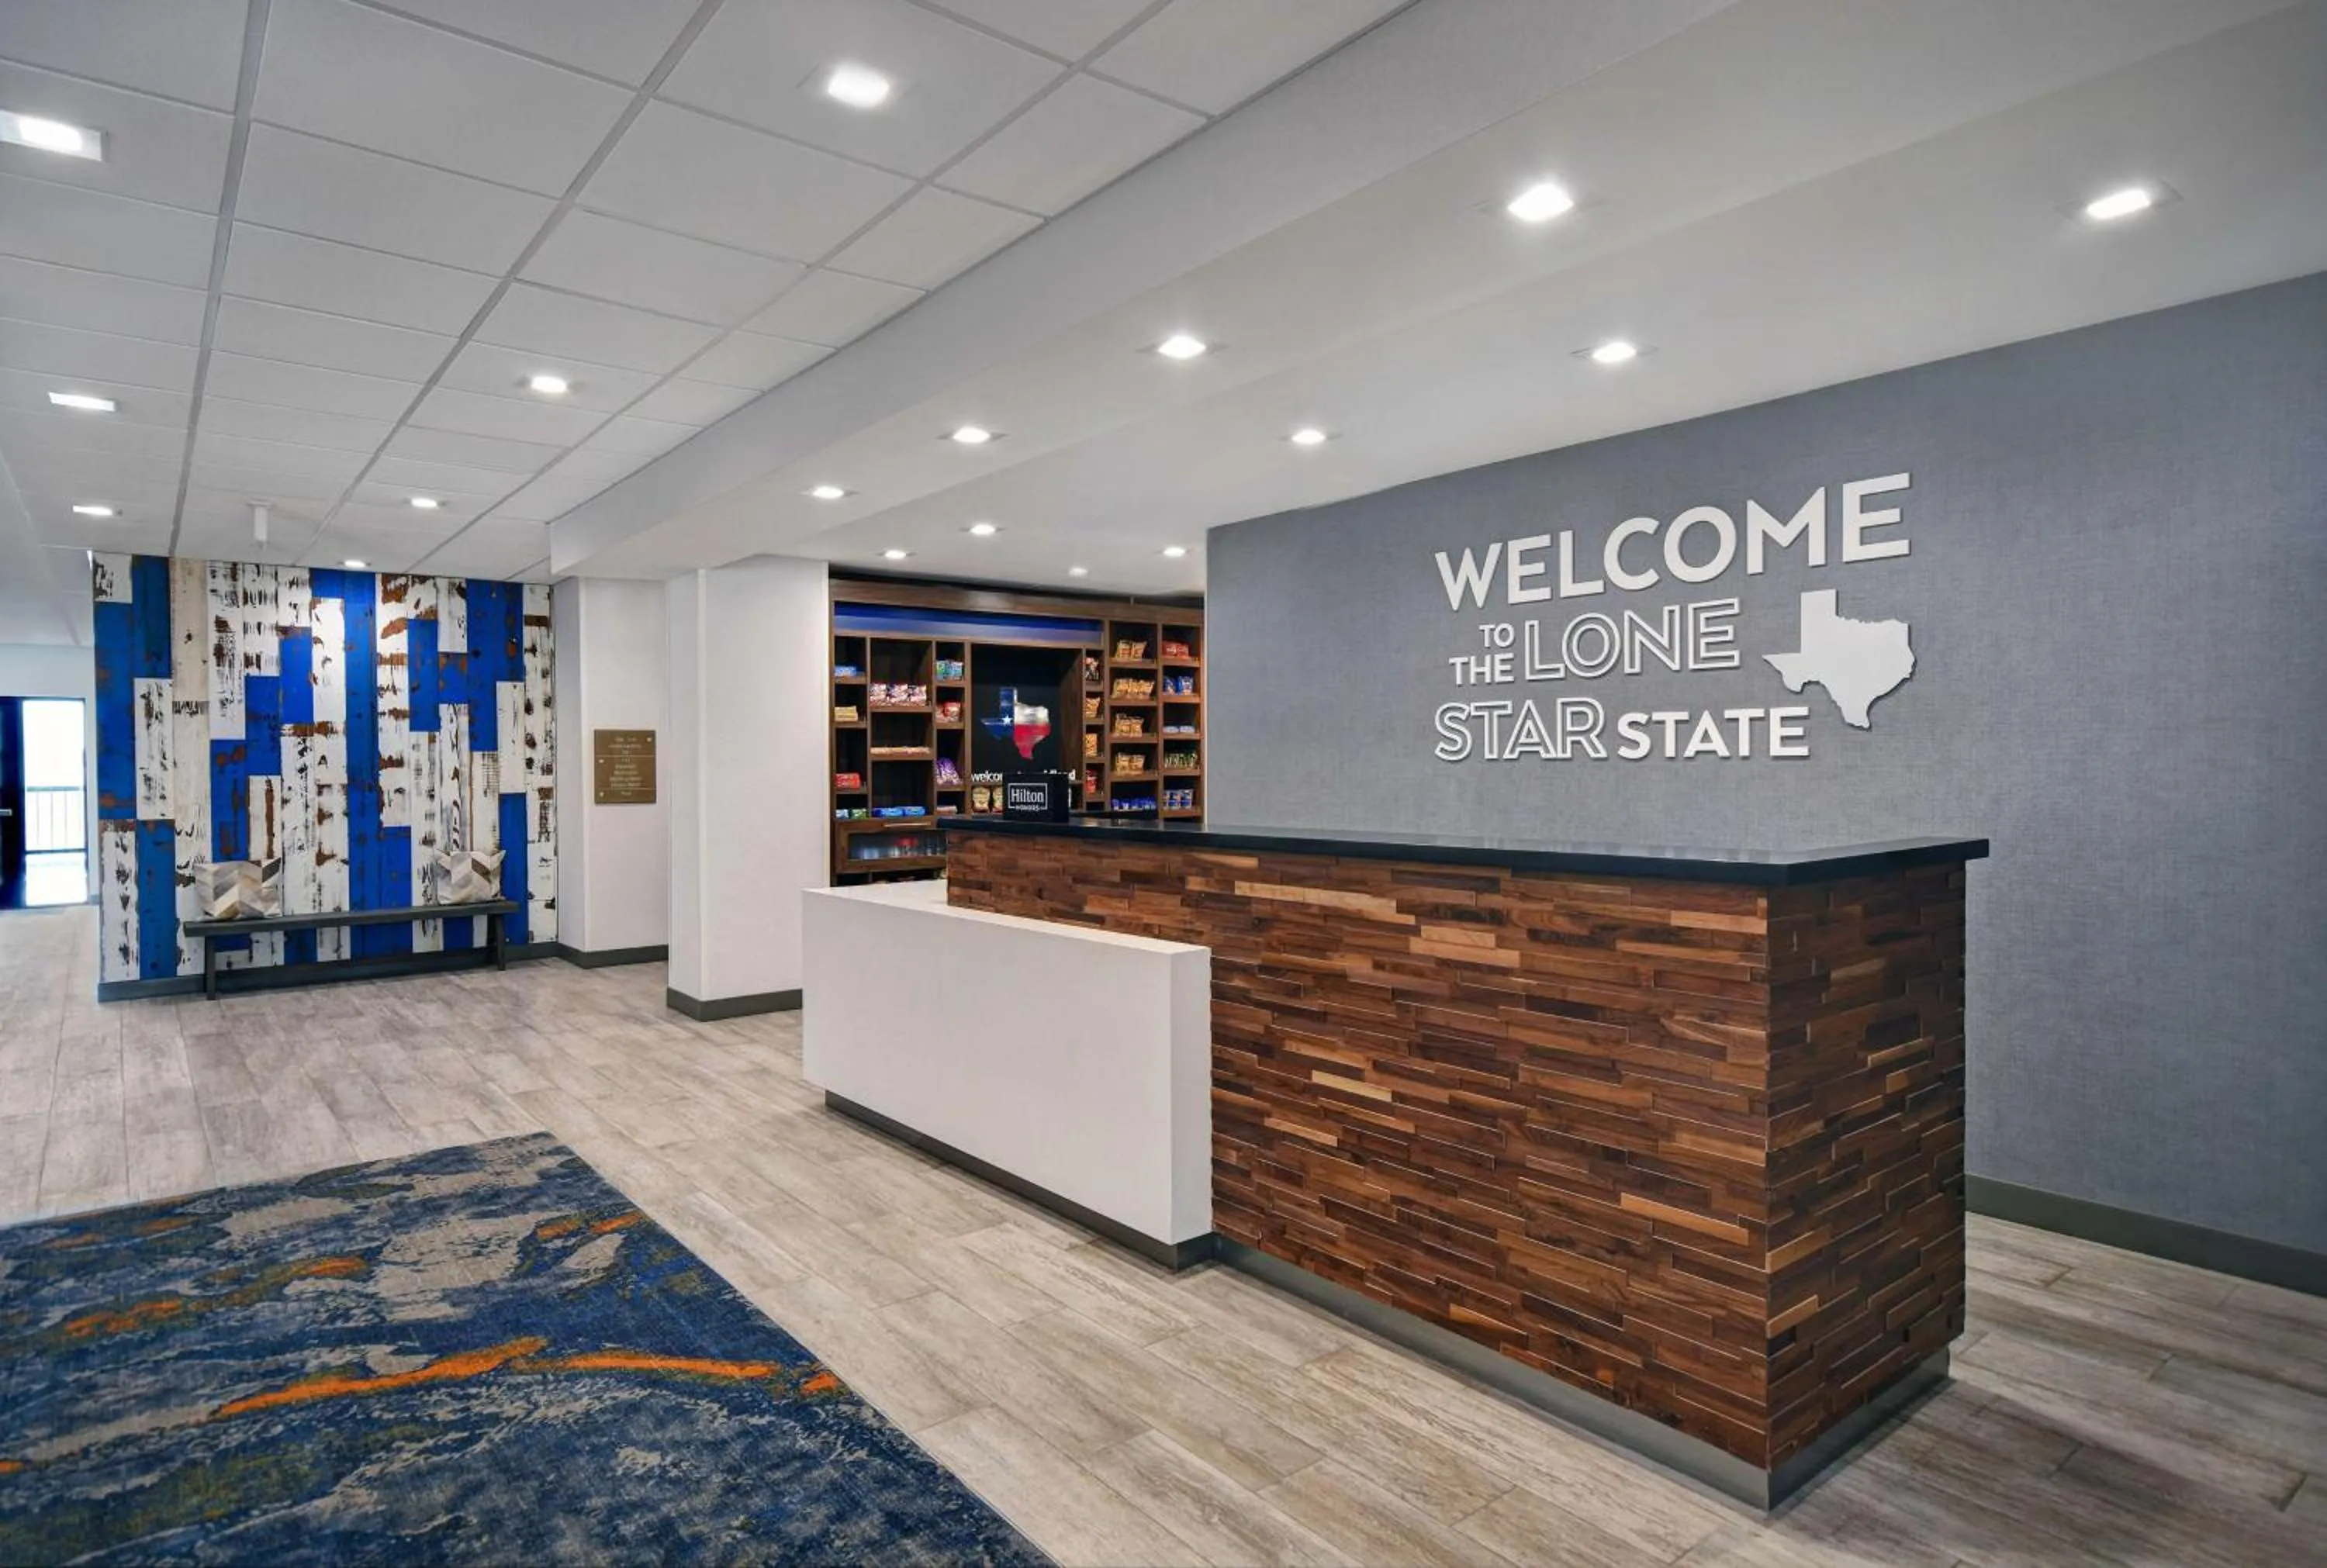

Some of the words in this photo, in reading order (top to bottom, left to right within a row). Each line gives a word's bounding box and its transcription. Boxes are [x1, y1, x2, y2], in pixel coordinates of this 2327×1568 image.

[1434, 472, 1910, 612] WELCOME
[1448, 653, 1516, 685] THE
[1524, 597, 1741, 681] LONE
[1478, 623, 1516, 648] TO
[1434, 696, 1609, 761] STAR
[1616, 706, 1810, 759] STATE
[971, 770, 1003, 782] welco
[1011, 789, 1044, 803] Hilton
